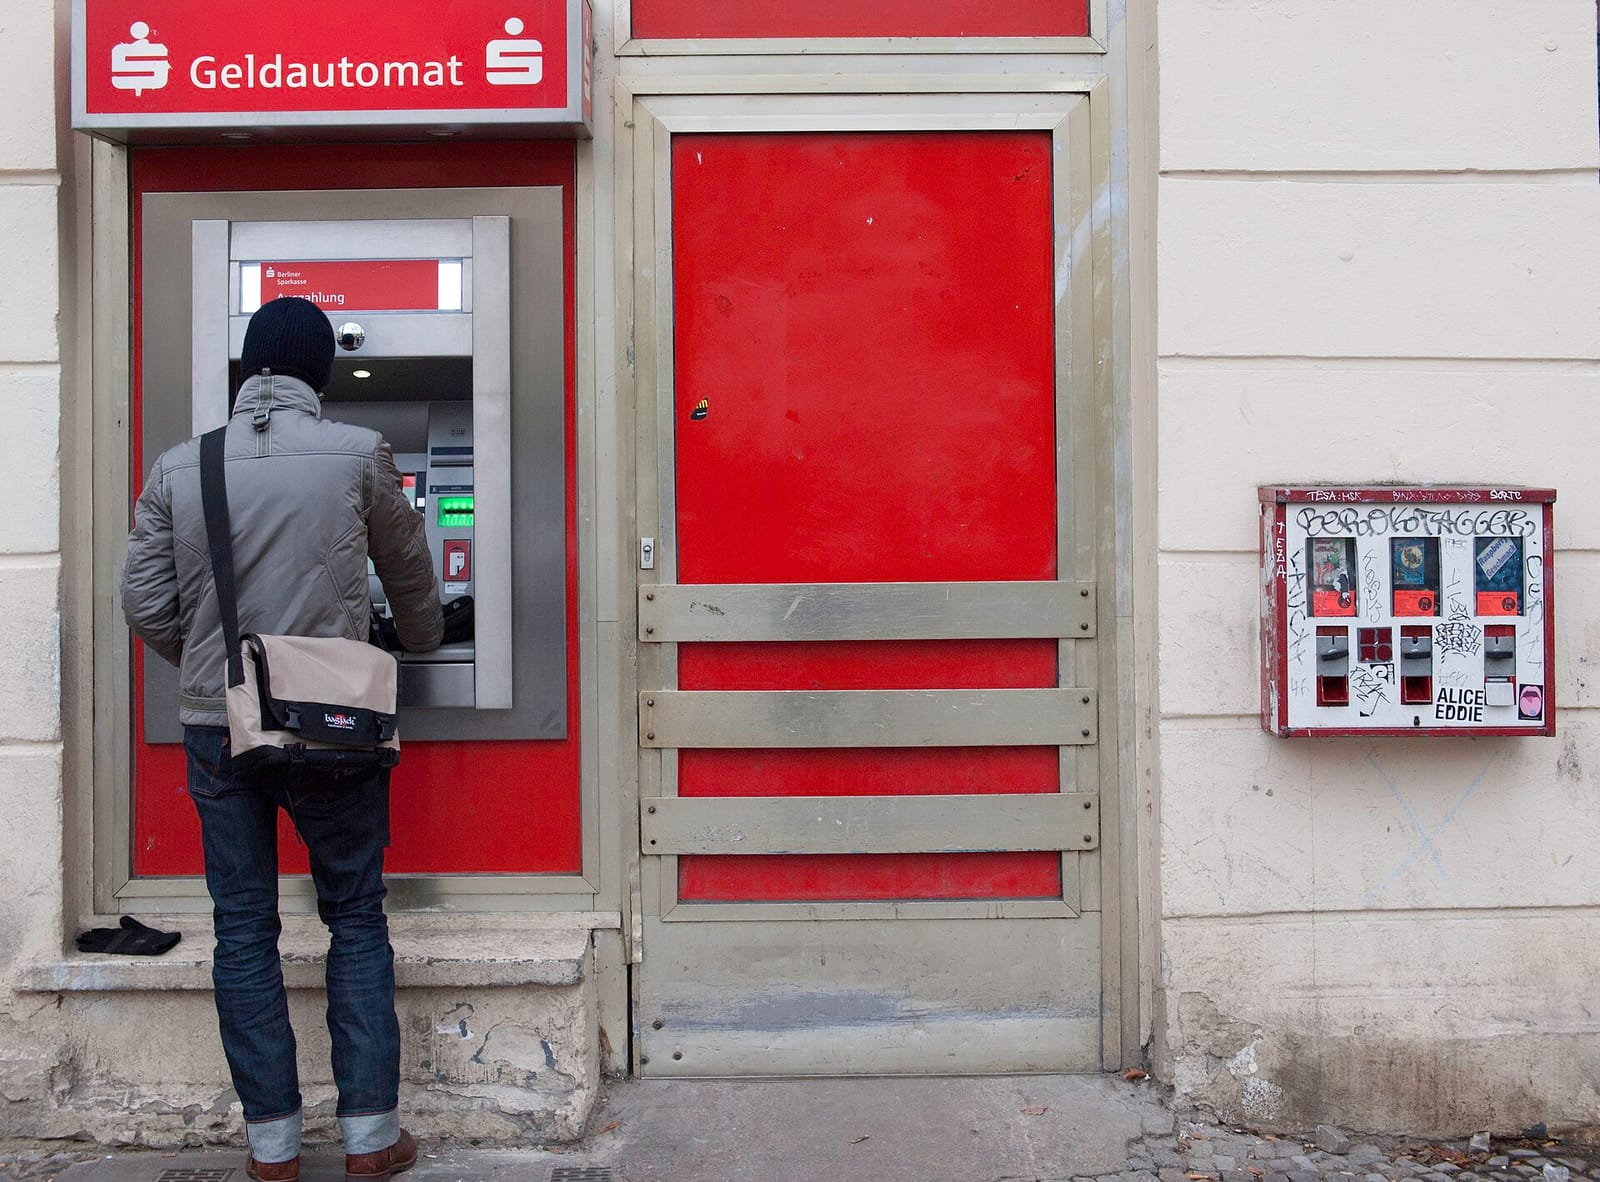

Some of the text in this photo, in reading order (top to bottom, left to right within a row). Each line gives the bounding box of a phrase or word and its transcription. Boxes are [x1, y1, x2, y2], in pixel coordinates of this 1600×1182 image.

[190, 54, 463, 89] Geldautomat
[1485, 544, 1517, 577] Geschmack
[1437, 687, 1484, 706] ALICE
[1435, 704, 1483, 722] EDDIE
